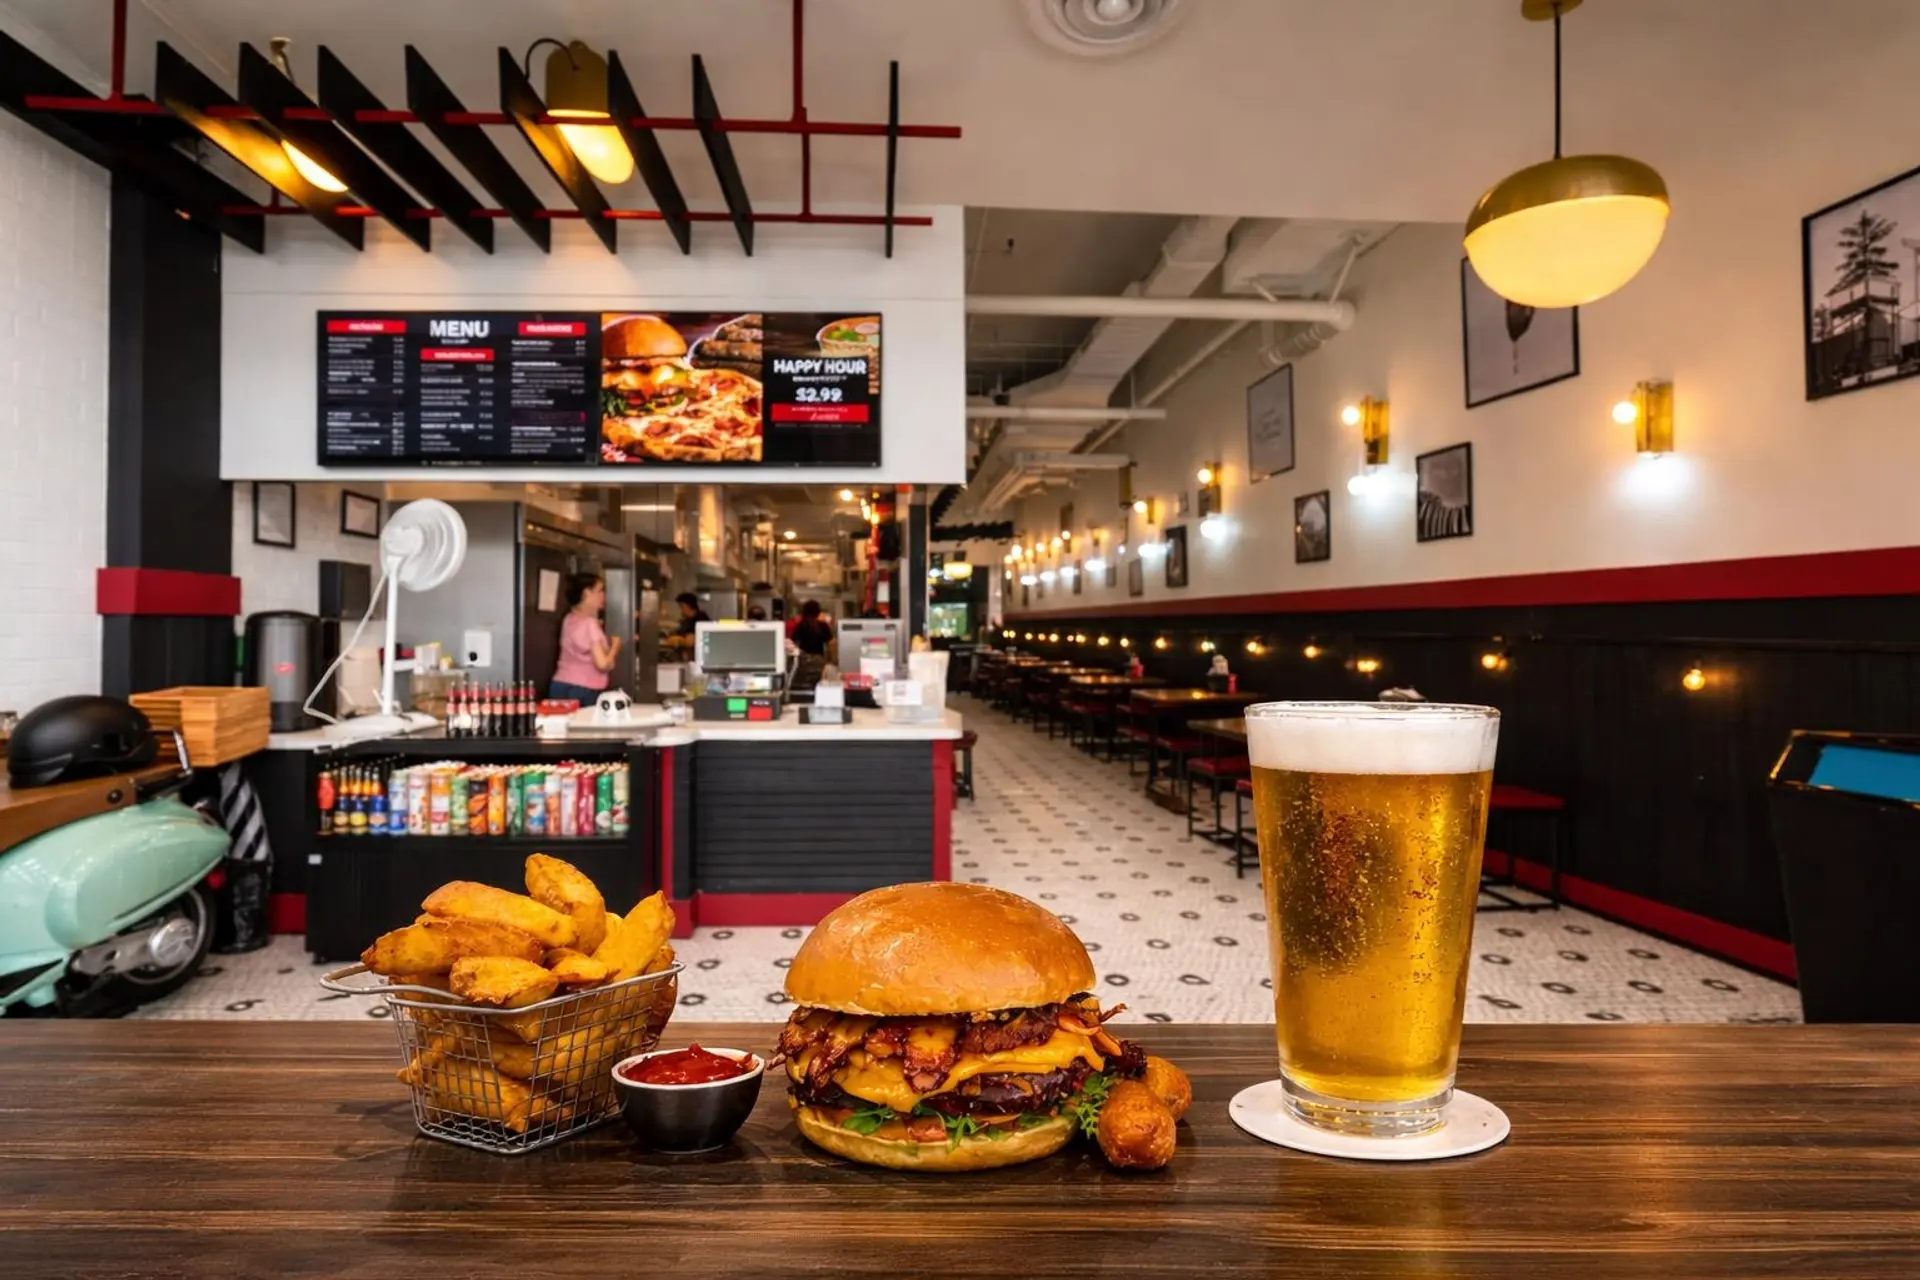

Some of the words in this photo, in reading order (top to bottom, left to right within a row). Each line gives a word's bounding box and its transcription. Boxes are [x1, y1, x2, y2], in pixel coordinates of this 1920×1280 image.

[430, 320, 490, 338] MENU
[773, 359, 823, 374] HAPPY
[824, 359, 867, 374] HOUR
